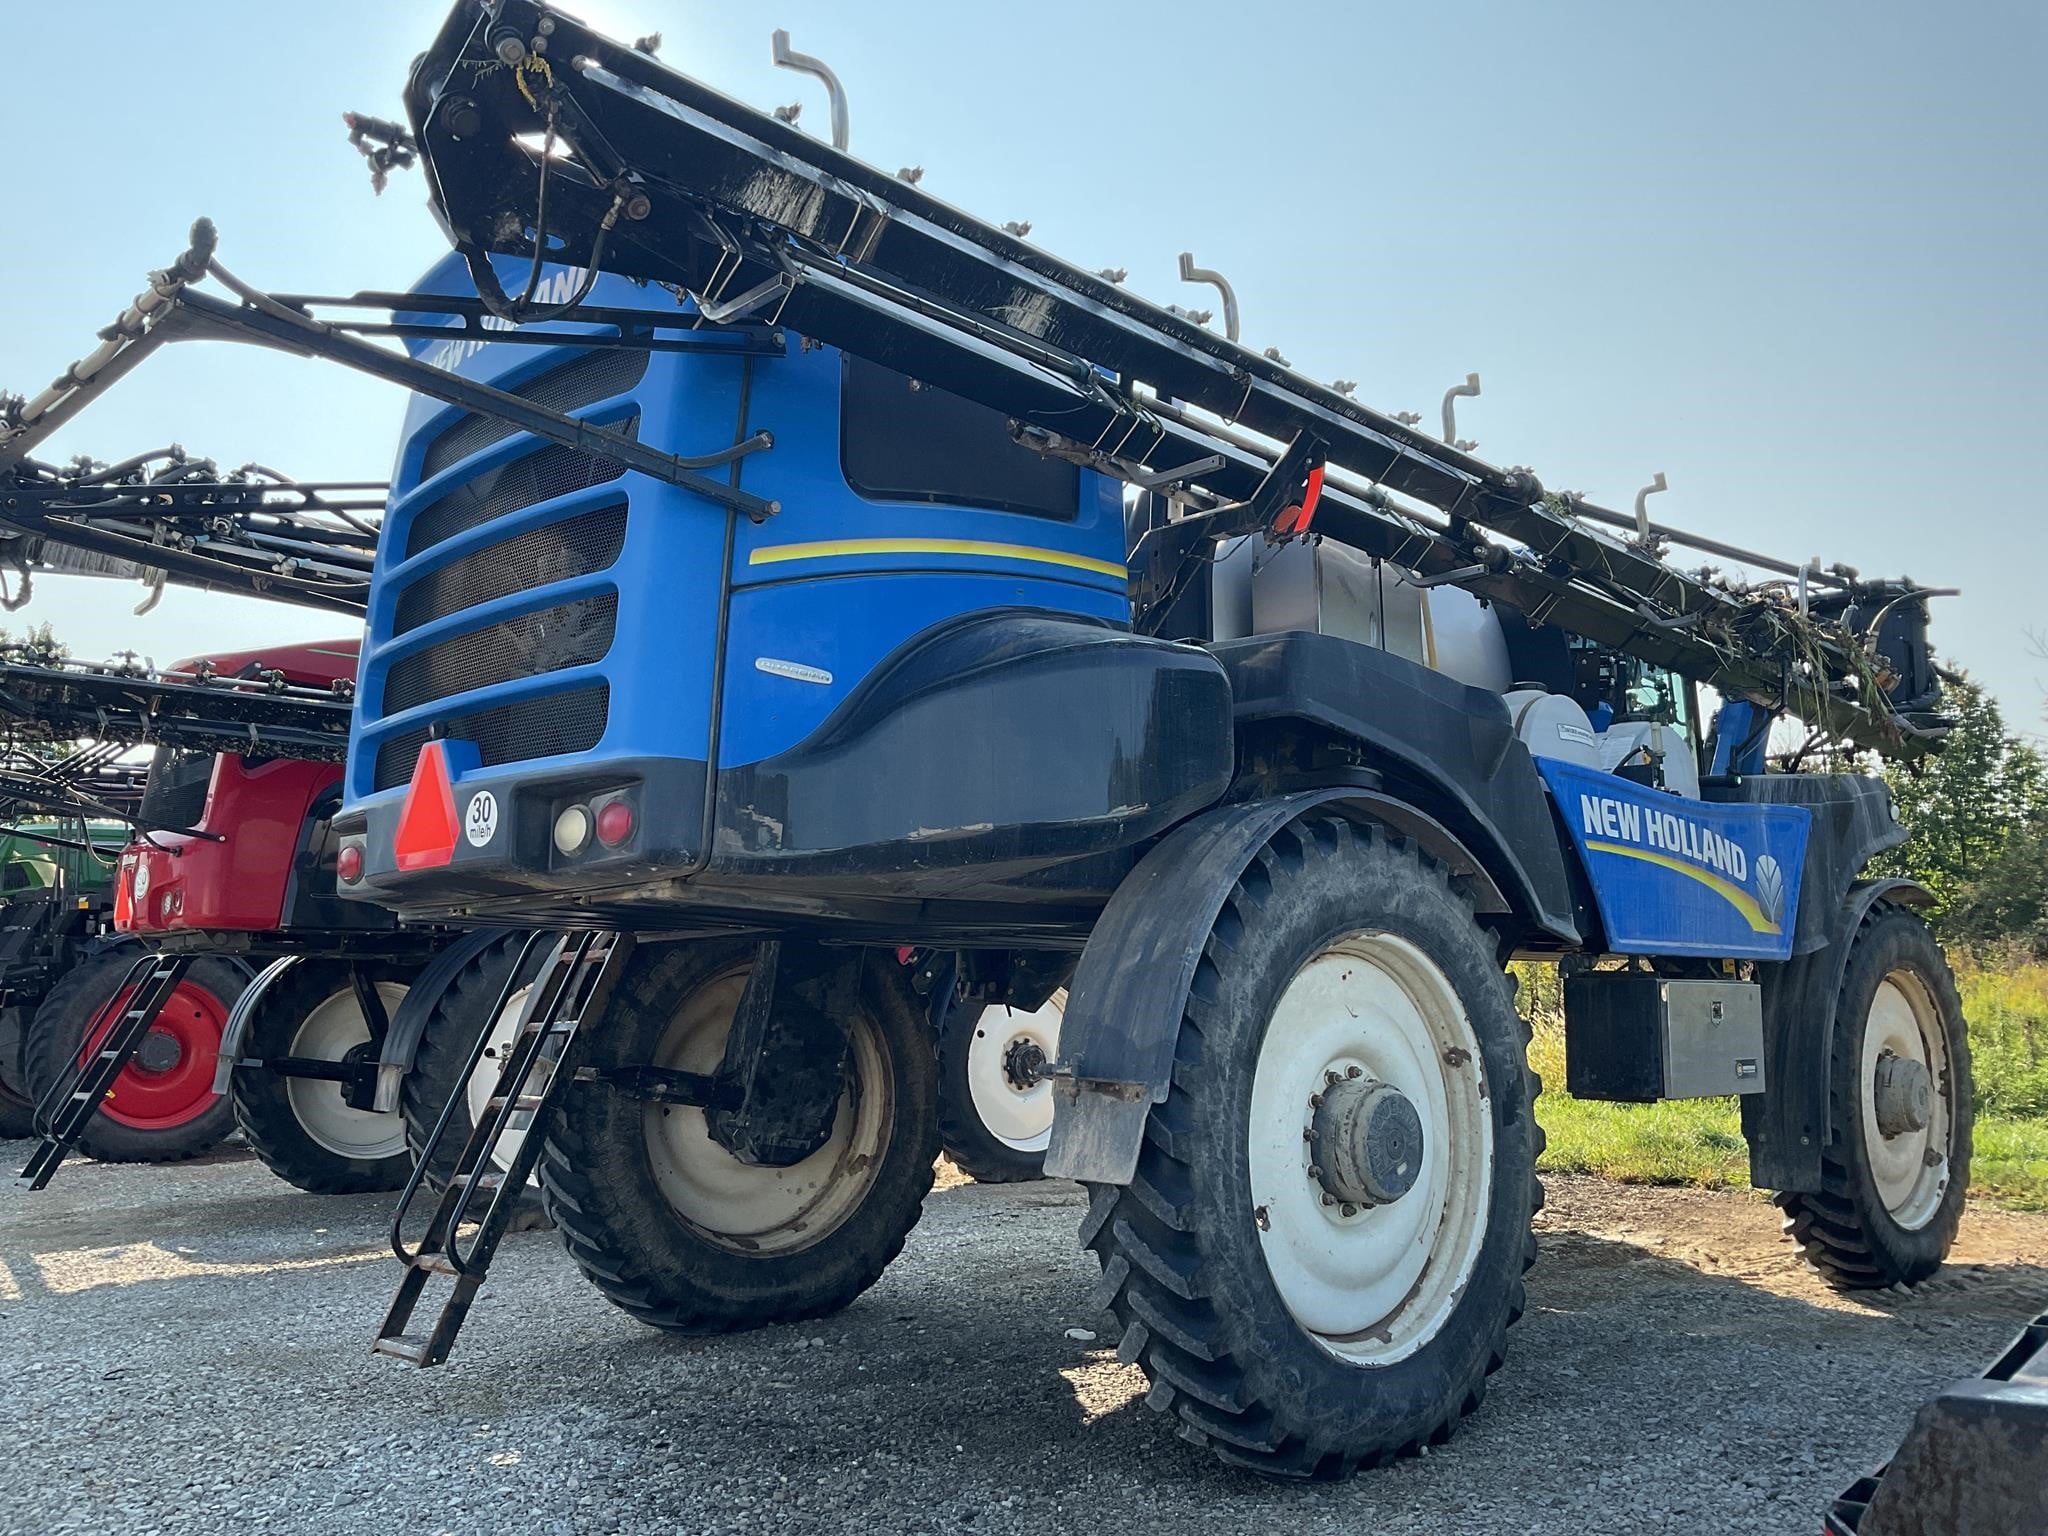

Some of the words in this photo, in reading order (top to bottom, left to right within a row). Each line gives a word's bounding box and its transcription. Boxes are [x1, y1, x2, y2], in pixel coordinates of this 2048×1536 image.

[472, 795, 491, 824] 30
[1580, 794, 1641, 842] NEW
[1645, 808, 1747, 882] HOLLAND
